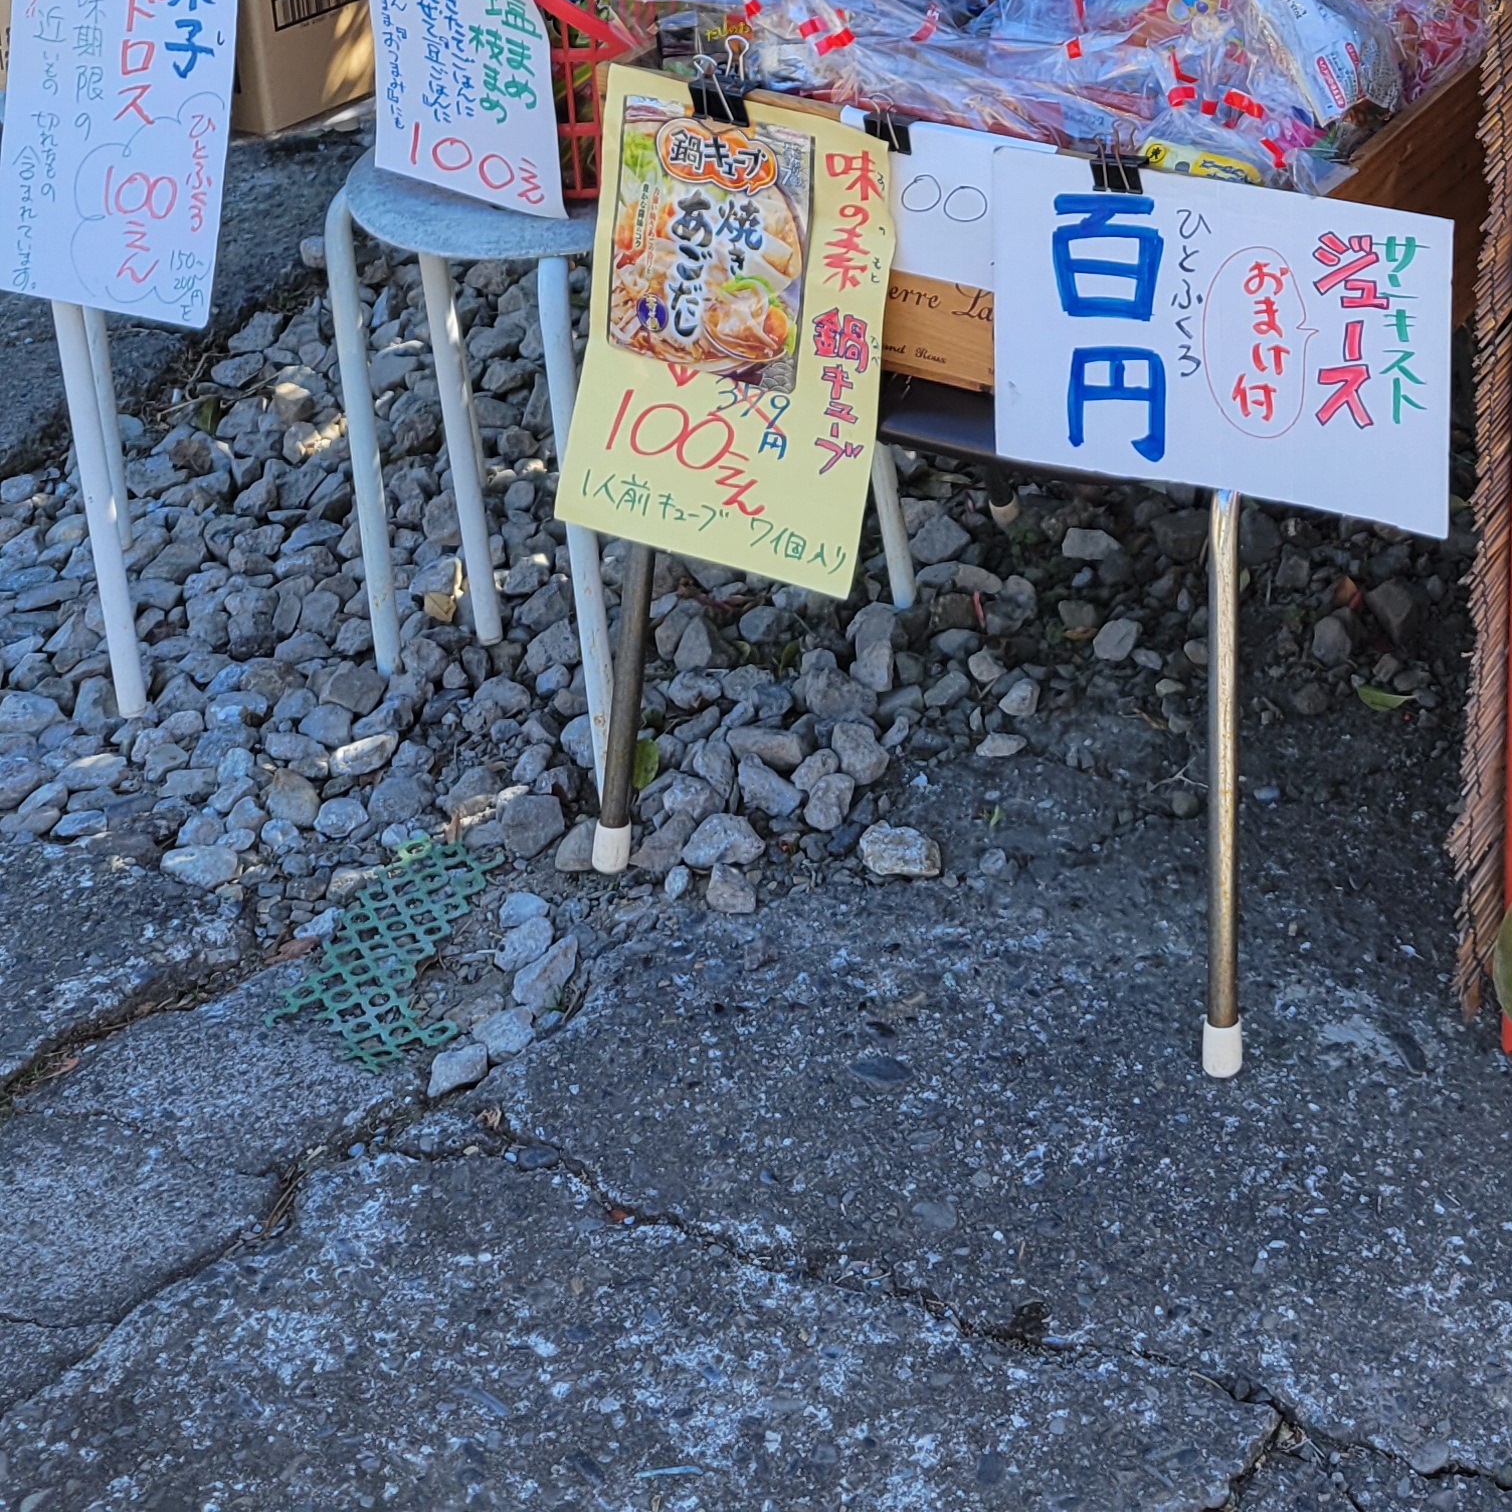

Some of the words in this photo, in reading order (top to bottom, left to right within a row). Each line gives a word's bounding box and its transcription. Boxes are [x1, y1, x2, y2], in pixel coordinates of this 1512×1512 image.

[33, 5, 68, 96] 近いもの
[468, 23, 508, 125] 枝まめ
[186, 112, 217, 234] ひとふくろ
[669, 127, 768, 180] 鍋キューブ
[822, 149, 883, 293] 味の素
[668, 188, 714, 338] あごだし
[715, 198, 764, 277] 焼き
[1169, 208, 1213, 378] ひとふくろ
[812, 306, 868, 475] 鍋キューブ
[1051, 193, 1167, 464] 百円
[1230, 259, 1292, 423] おまけ付
[1312, 230, 1391, 430] ジュース
[1371, 234, 1431, 426] サンキスト
